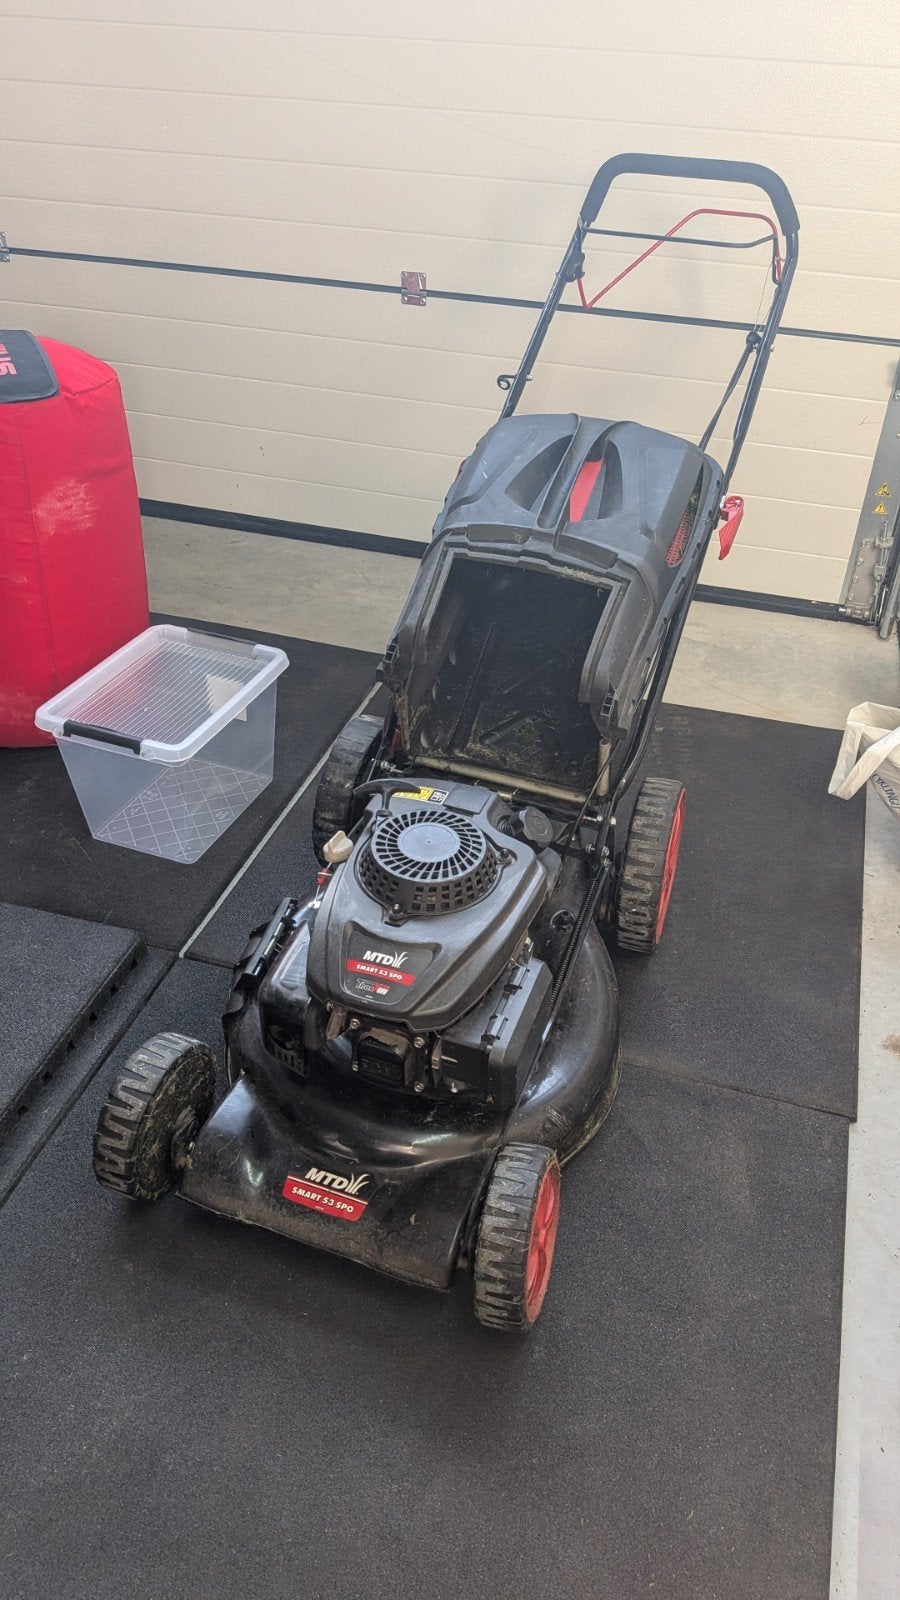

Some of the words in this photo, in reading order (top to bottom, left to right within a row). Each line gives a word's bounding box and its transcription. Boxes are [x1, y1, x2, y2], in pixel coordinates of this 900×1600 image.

[362, 951, 394, 965] MTD
[356, 964, 378, 973] SMART
[388, 972, 403, 980] SPO
[305, 1168, 349, 1189] MTD
[292, 1187, 321, 1201] SMART
[322, 1197, 334, 1207] 53
[335, 1201, 354, 1213] SPO
